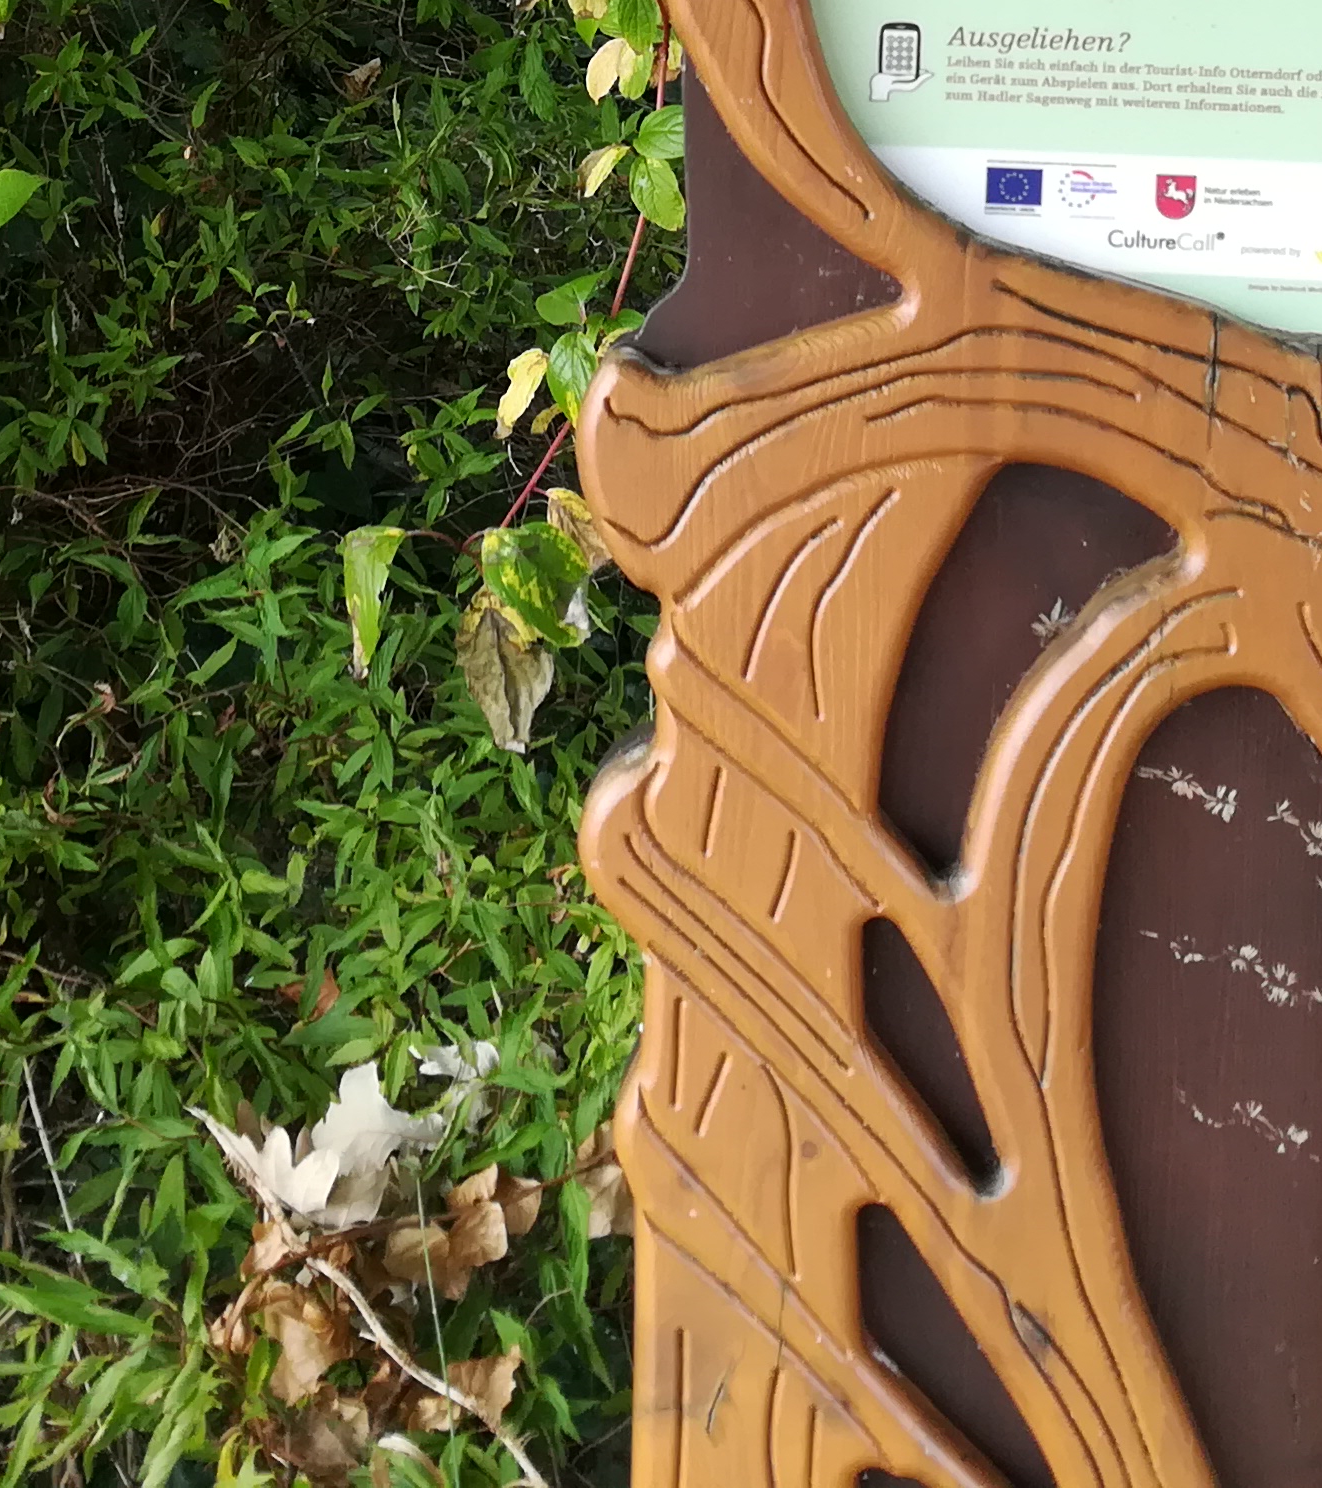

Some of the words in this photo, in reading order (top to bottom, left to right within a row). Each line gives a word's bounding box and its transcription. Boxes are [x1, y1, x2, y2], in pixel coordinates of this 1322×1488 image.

[947, 26, 1131, 54] Ausgeliehen?
[947, 56, 990, 69] Leihen
[994, 58, 1013, 70] Sie
[1018, 59, 1045, 71] sich
[1049, 60, 1098, 72] einfach
[1102, 61, 1116, 73] in
[1119, 62, 1141, 74] der
[1144, 63, 1226, 78] Tourist-Info
[1230, 67, 1303, 81] Otterndorf
[946, 74, 966, 84] ein
[970, 74, 1006, 85] Gerät
[1010, 77, 1038, 87] zum
[1042, 76, 1107, 91] Abspielen
[1111, 80, 1138, 91] aus.
[1143, 80, 1172, 92] Dort
[1176, 81, 1232, 95] erhalten
[1236, 84, 1257, 96] Sie
[1260, 85, 1292, 97] auch
[1296, 86, 1317, 98] die
[945, 92, 973, 101] zum
[977, 90, 1023, 103] Hadler
[1026, 92, 1092, 108] Sagenweg
[1096, 95, 1119, 107] mit
[1122, 96, 1180, 110] weiteren
[1185, 98, 1284, 114] Informationen.
